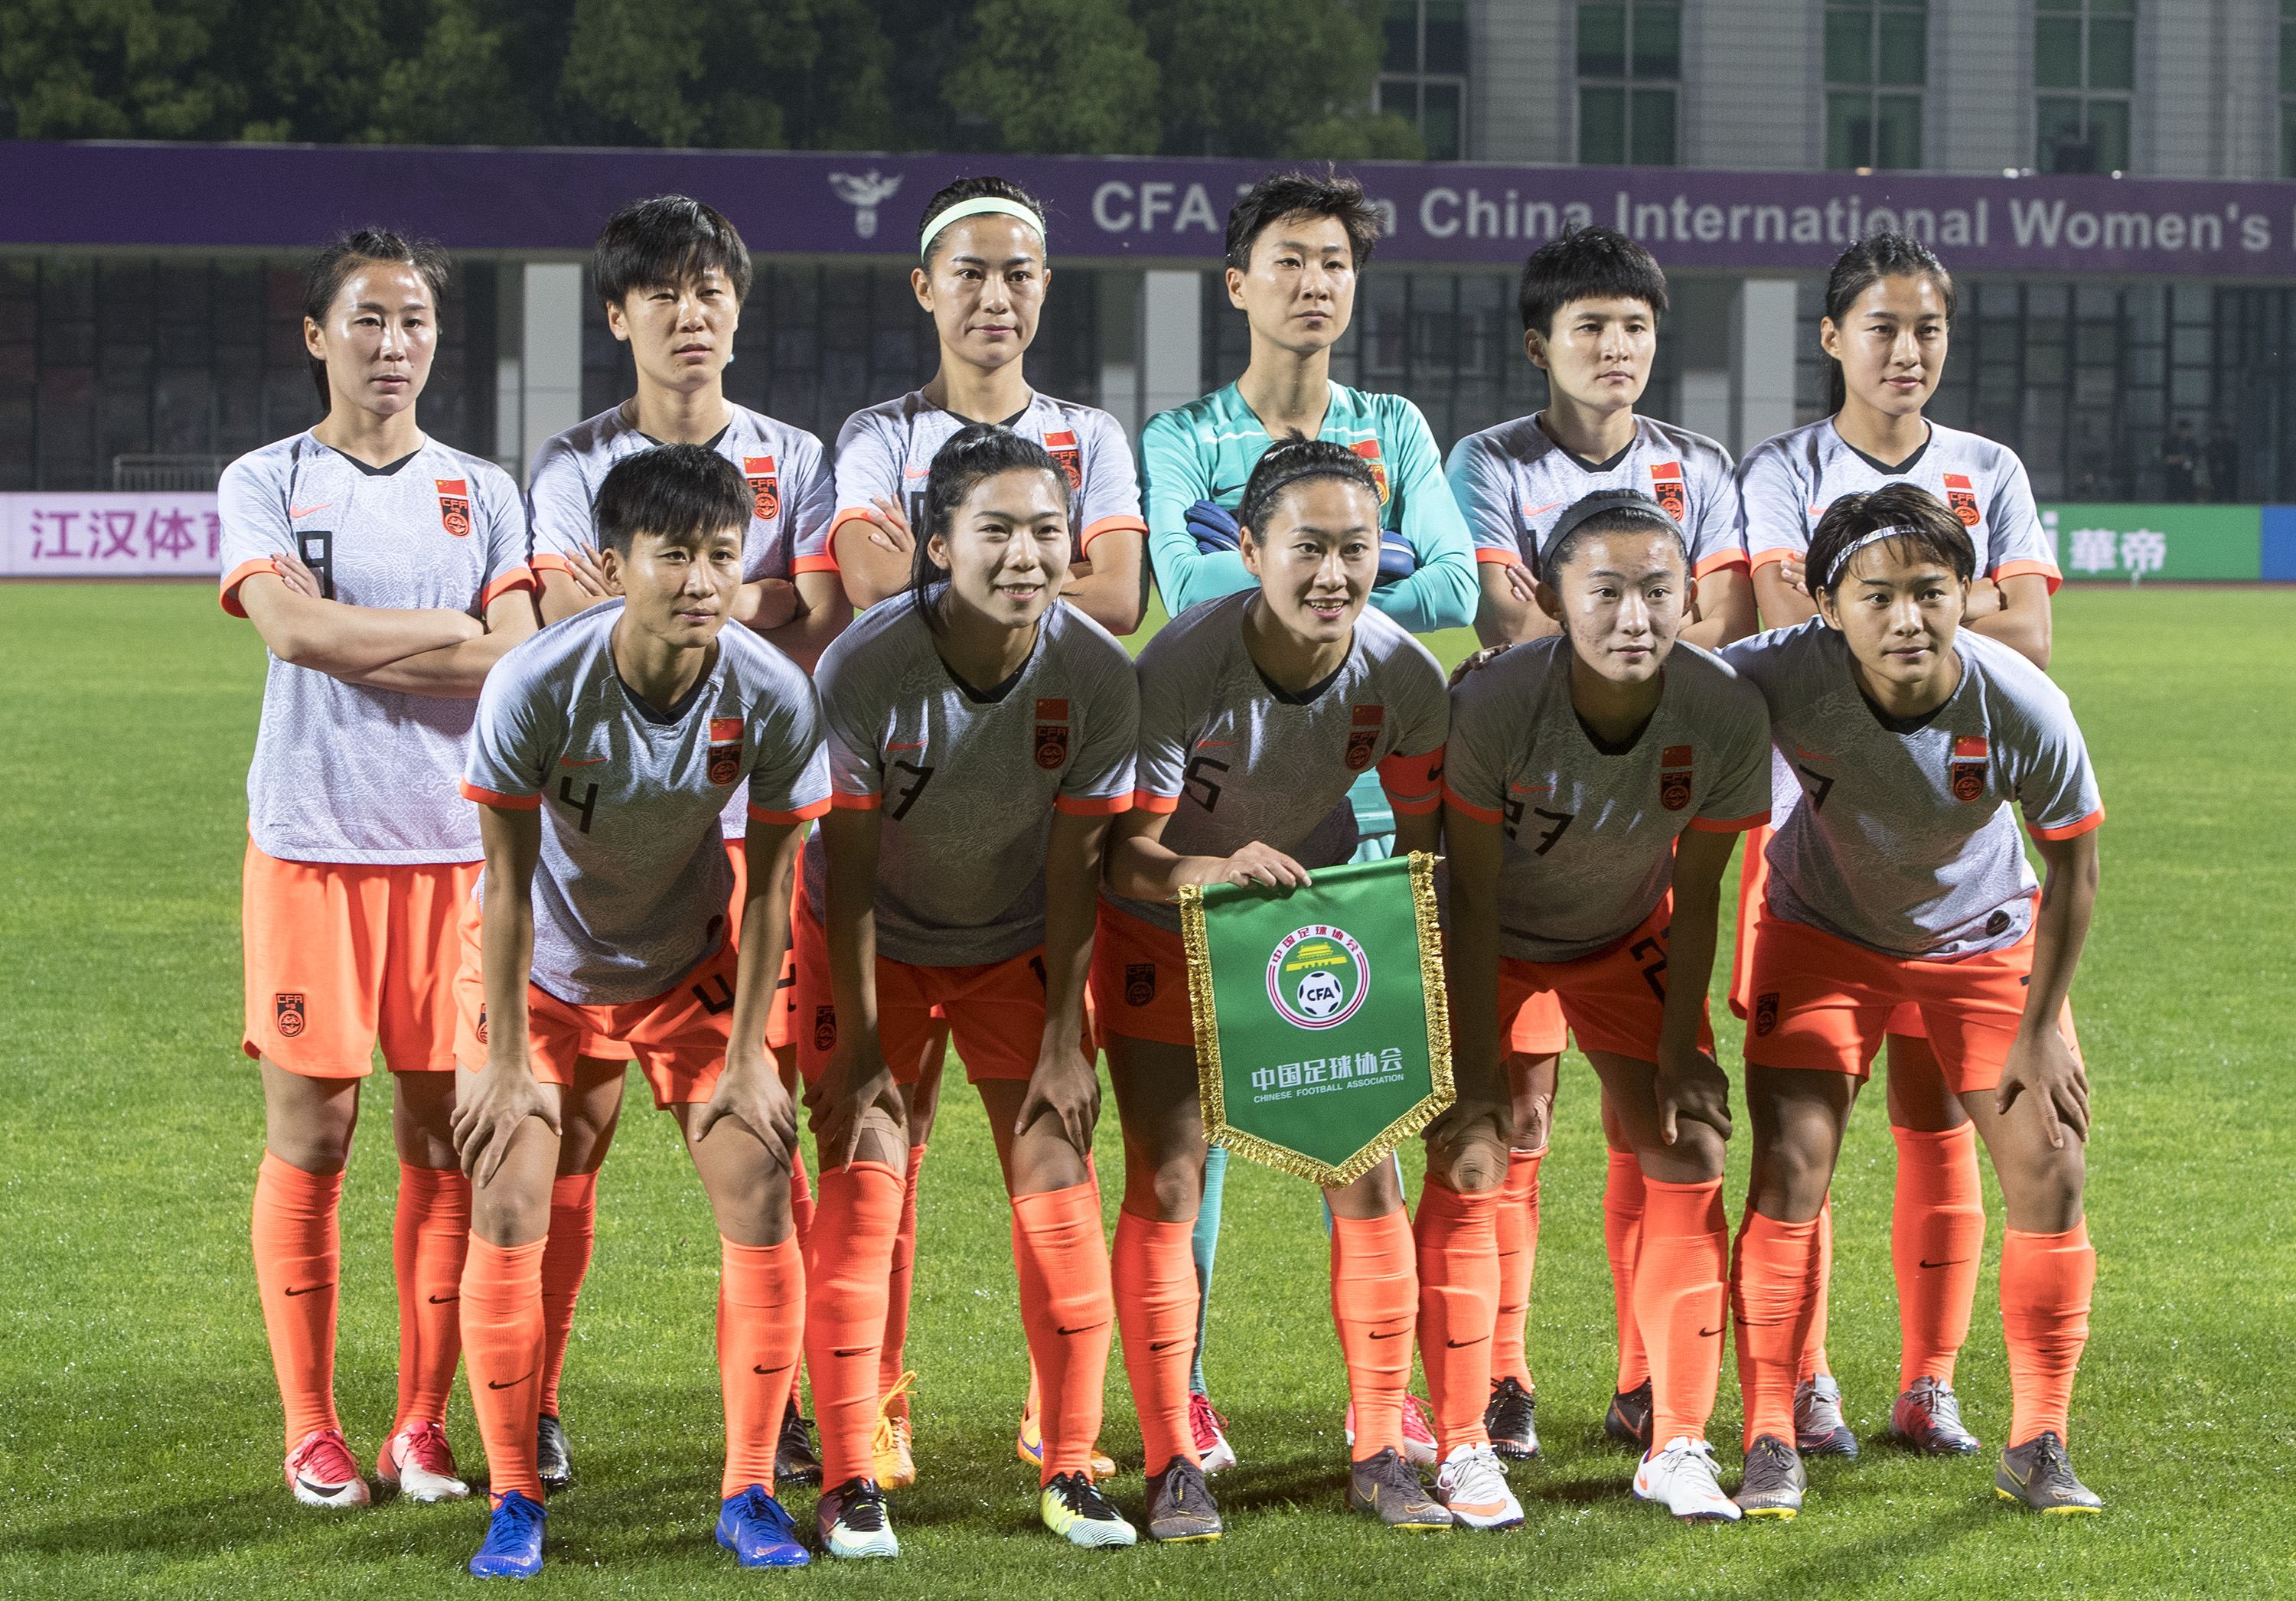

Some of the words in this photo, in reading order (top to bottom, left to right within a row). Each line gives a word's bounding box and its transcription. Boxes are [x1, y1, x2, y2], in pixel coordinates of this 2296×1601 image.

[1092, 181, 1220, 233] CFA
[1420, 187, 1594, 242] China
[1616, 192, 1988, 246] International
[2010, 200, 2272, 252] Women's
[748, 478, 776, 487] CFA
[1656, 484, 1682, 494] CFA
[1949, 493, 1975, 502] CFA
[442, 498, 468, 509] CFA
[894, 759, 935, 822] 7
[1186, 756, 1231, 814] 5
[1798, 763, 1835, 817] 7
[559, 775, 599, 836] 4
[1271, 925, 1358, 963] 中国足球协会
[277, 995, 303, 1003] CFA
[1306, 986, 1335, 1002] CFA
[1251, 1047, 1403, 1091] 中国足球协会
[1254, 1091, 1292, 1104] CHINESE
[1296, 1083, 1343, 1097] FOOTBALL
[1346, 1073, 1404, 1088] ASSOCIATION
